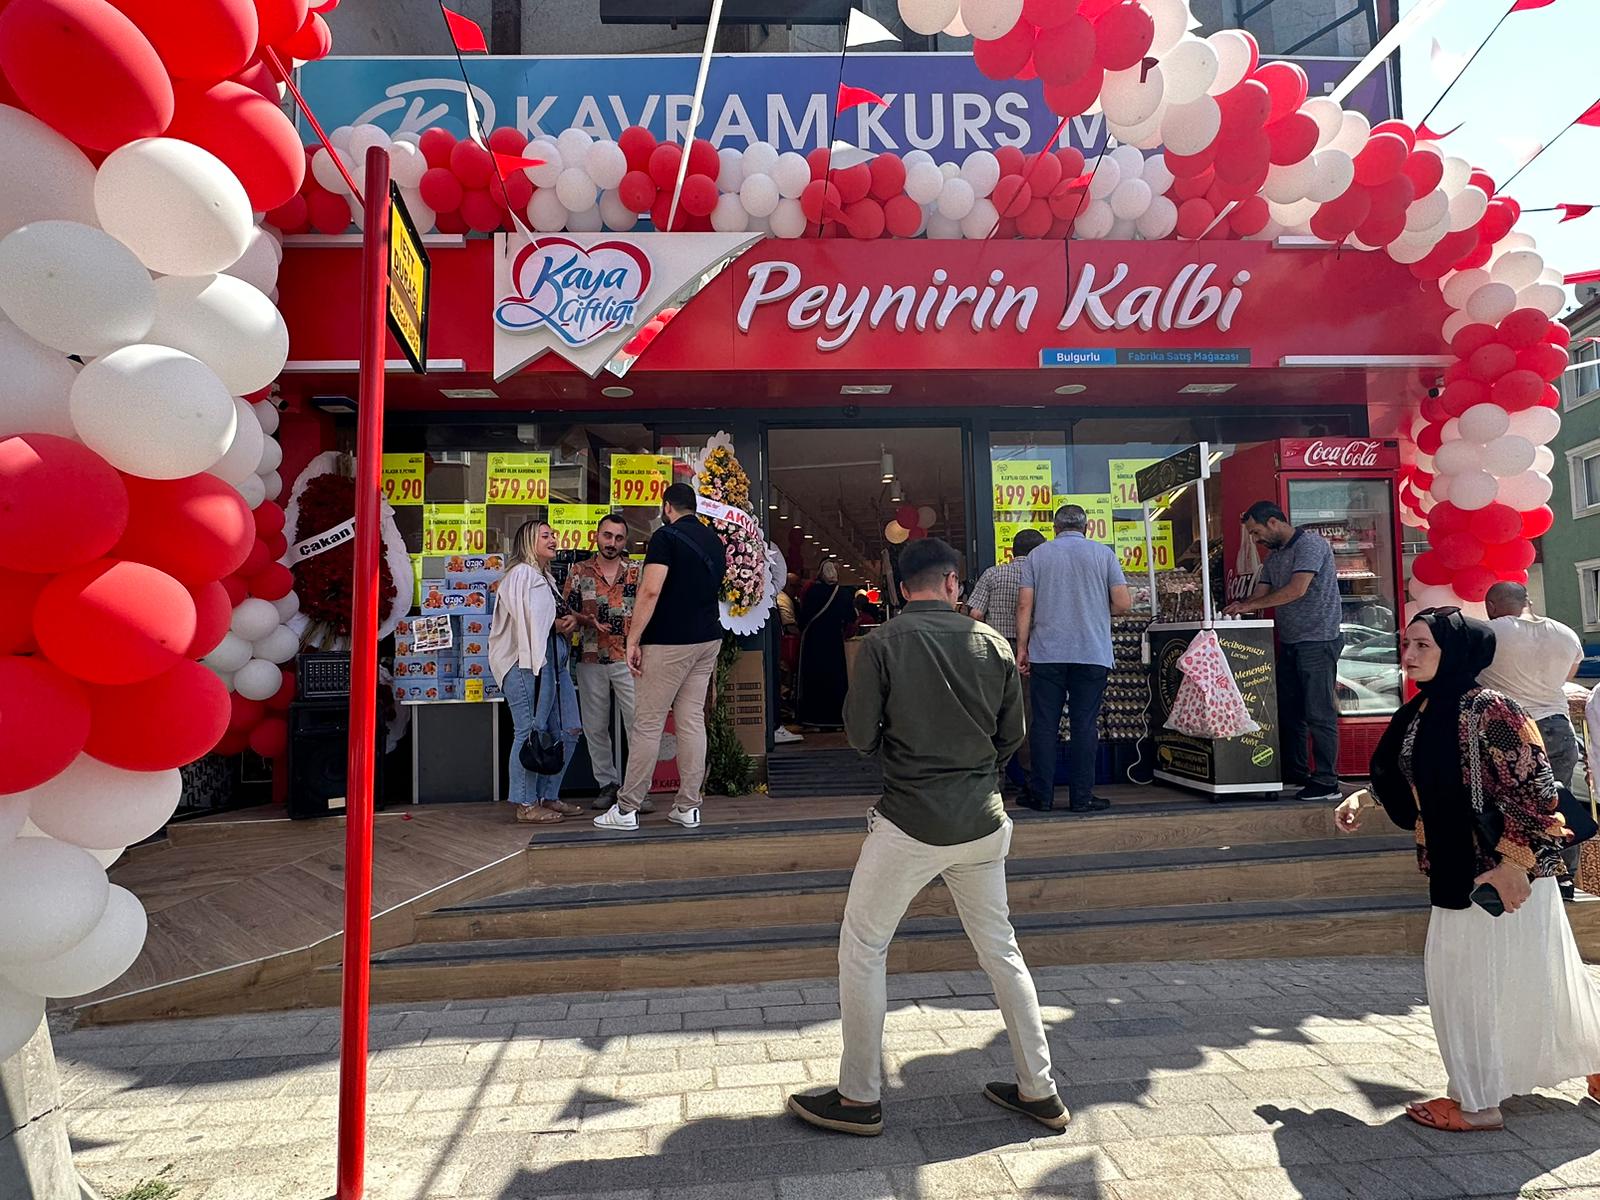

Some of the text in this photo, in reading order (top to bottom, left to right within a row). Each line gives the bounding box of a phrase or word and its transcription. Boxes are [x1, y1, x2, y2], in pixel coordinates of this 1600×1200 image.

[516, 93, 828, 150] KAVRAM
[857, 92, 1031, 150] KURS
[529, 252, 629, 300] Kaya
[737, 261, 1251, 350] Peynirin Kalbi
[1056, 352, 1239, 364] Bulgurlu Fabrika Satış Mağazası
[385, 478, 423, 501] 9,90
